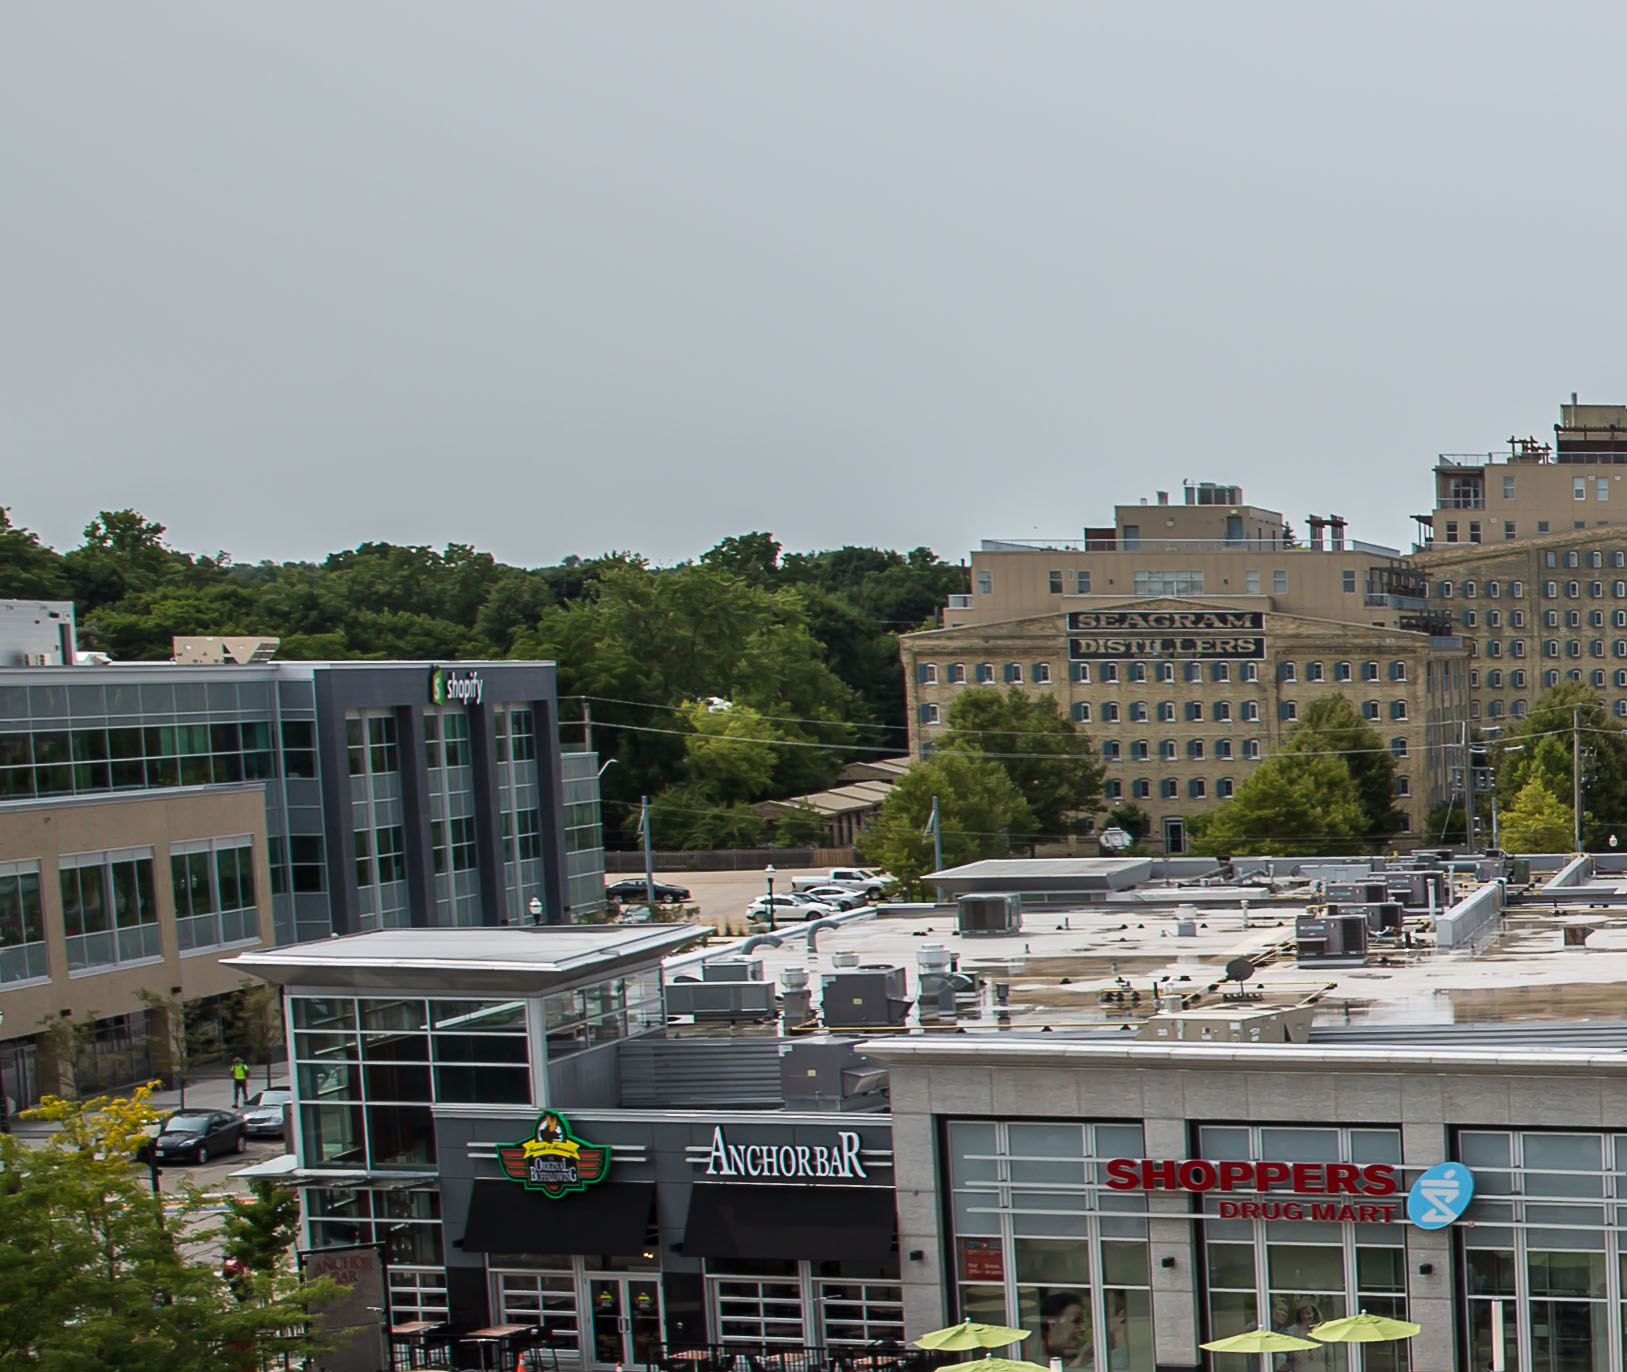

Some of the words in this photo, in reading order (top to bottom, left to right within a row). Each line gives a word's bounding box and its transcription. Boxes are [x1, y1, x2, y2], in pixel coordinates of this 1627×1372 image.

[1077, 614, 1255, 629] SEAGRAM
[1077, 638, 1257, 654] DISTILLERS
[446, 671, 484, 704] shopify
[1105, 1158, 1398, 1197] SHOPPERS
[1218, 1200, 1302, 1221] DRUG
[1310, 1202, 1397, 1225] MART
